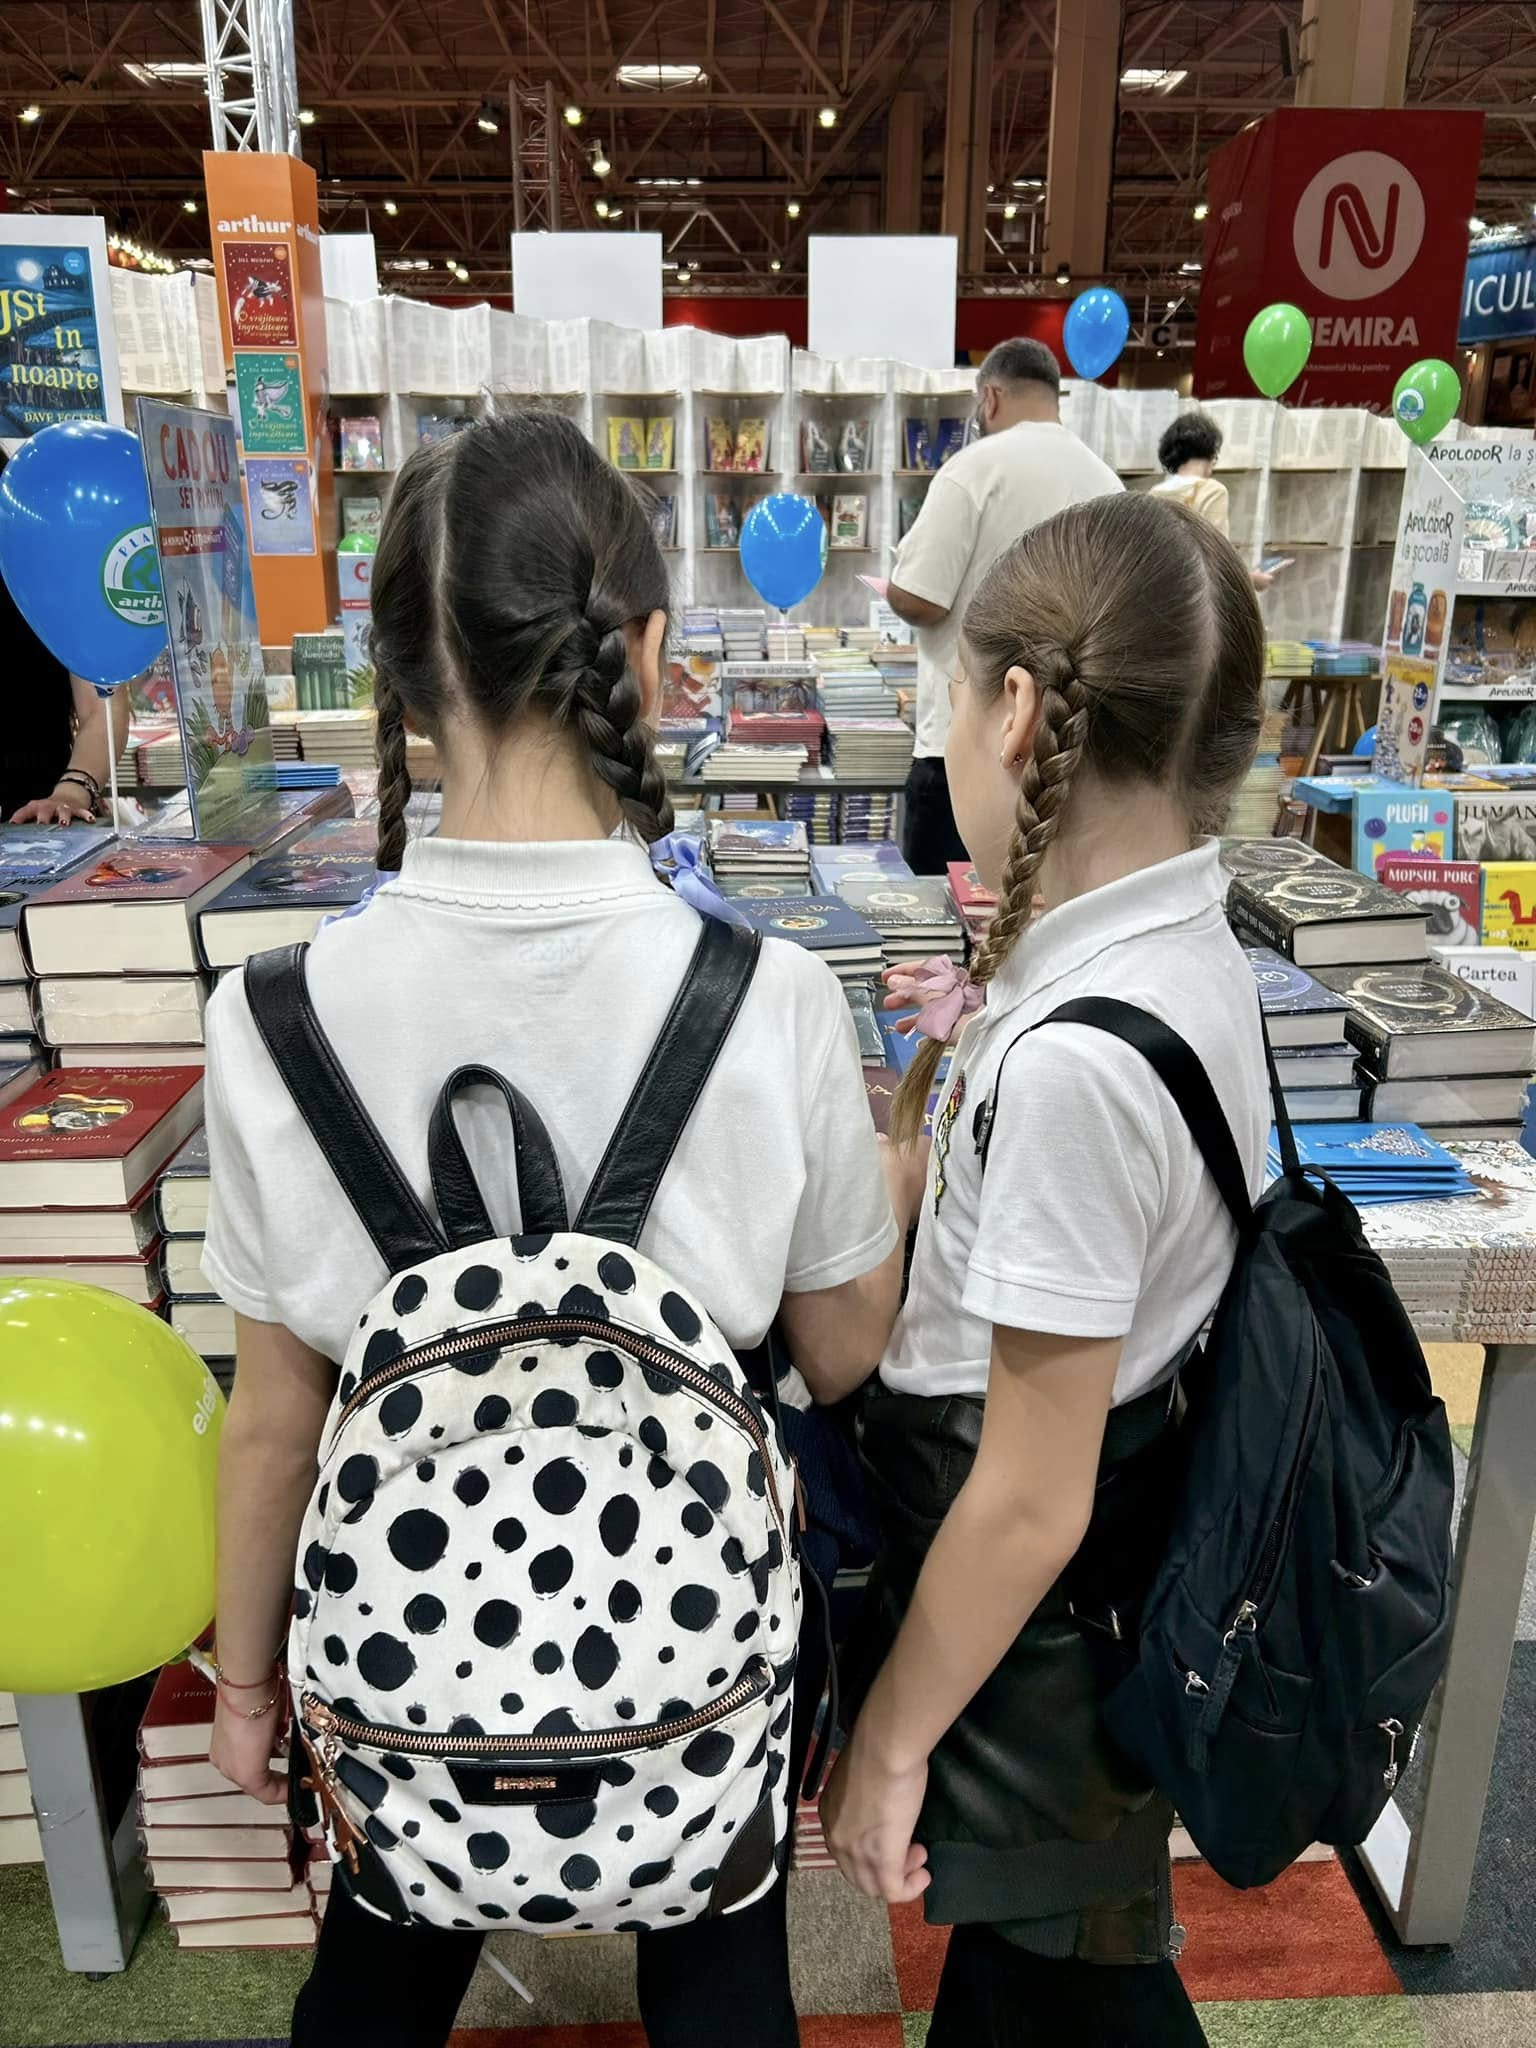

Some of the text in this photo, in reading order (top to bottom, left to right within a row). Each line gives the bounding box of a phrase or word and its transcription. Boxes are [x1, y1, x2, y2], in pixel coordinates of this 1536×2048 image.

[217, 214, 292, 233] arthur
[1151, 326, 1171, 347] C
[11, 363, 99, 391] noapte
[24, 411, 52, 423] DAVE
[161, 423, 230, 485] CADOU
[1428, 444, 1503, 464] APOLODOR
[1508, 444, 1522, 461] la
[1404, 511, 1455, 539] APOLODOR
[118, 595, 162, 608] arth
[1388, 868, 1477, 884] MOPSUL PORC
[1457, 965, 1519, 982] Cartea
